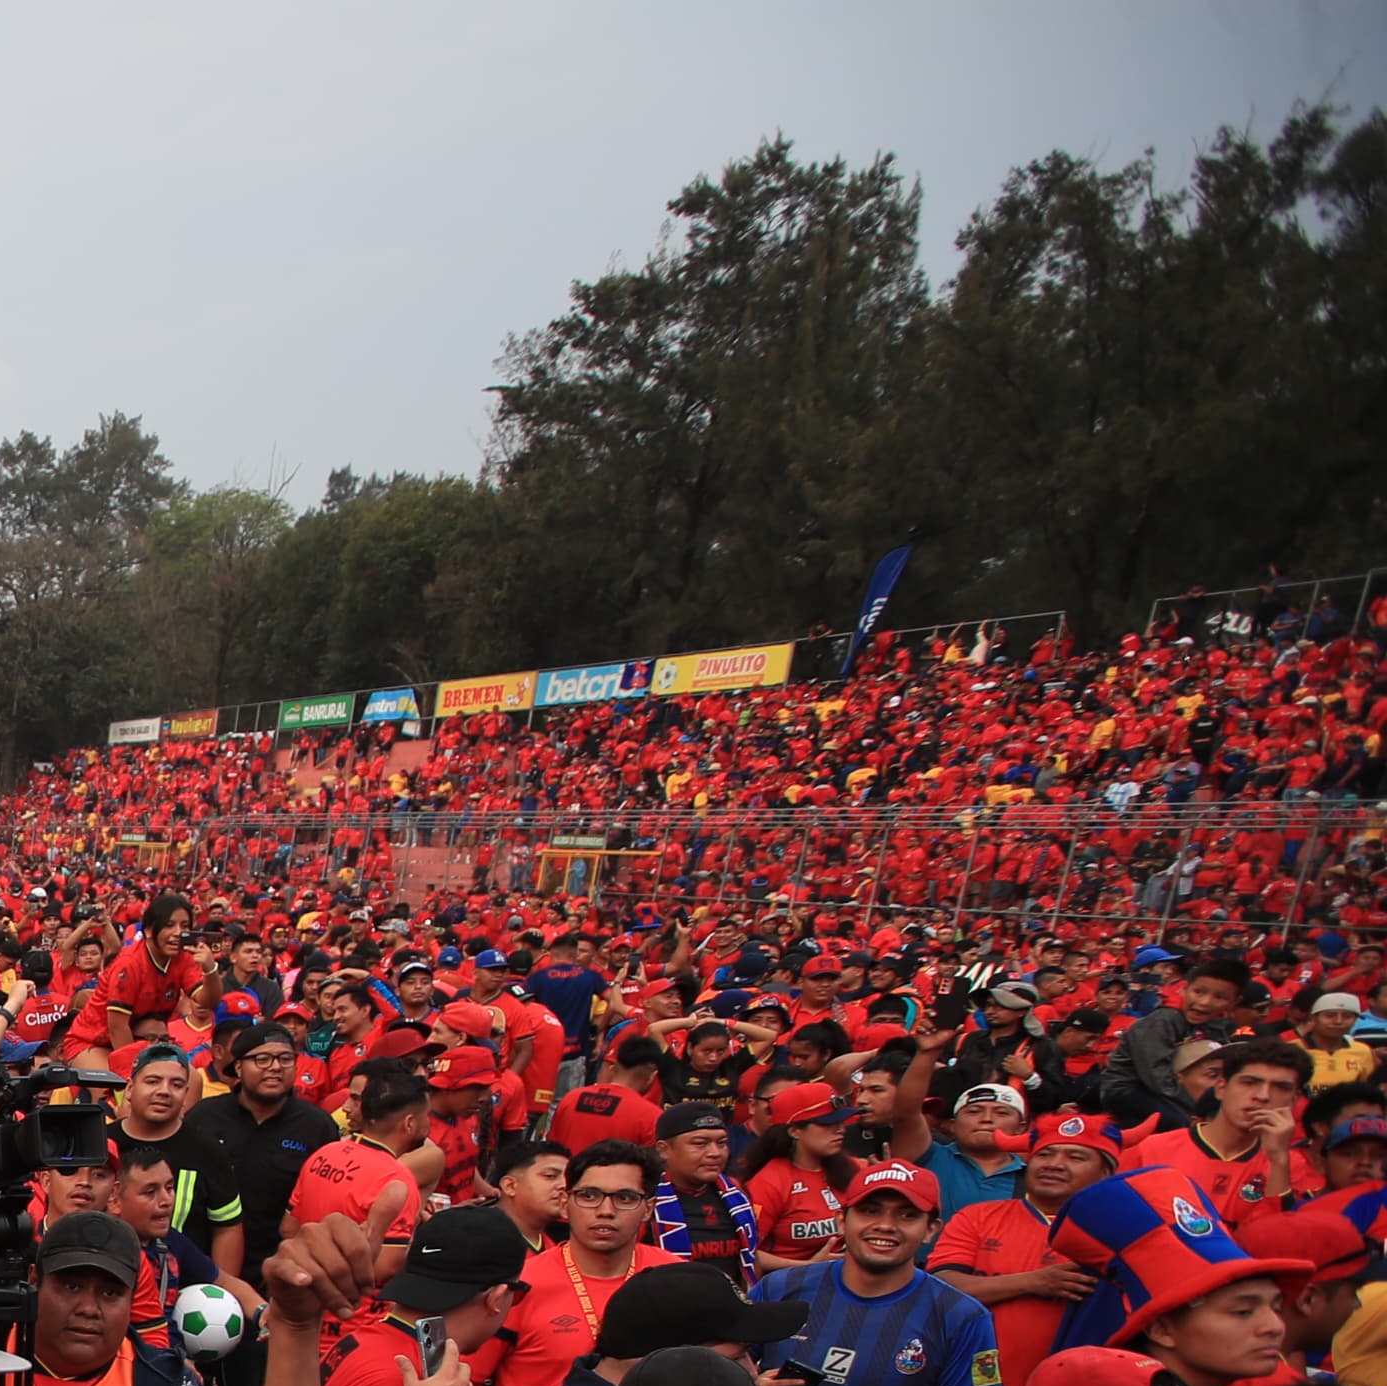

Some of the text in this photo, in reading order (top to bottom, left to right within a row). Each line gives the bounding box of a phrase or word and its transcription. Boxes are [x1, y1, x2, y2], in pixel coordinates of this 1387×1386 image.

[442, 684, 504, 708] BREMEN
[303, 701, 347, 722] BANRURAL
[25, 1010, 62, 1026] Claro
[309, 1155, 345, 1183] Claro
[864, 1167, 907, 1185] PUMA
[827, 1349, 848, 1372] Z
